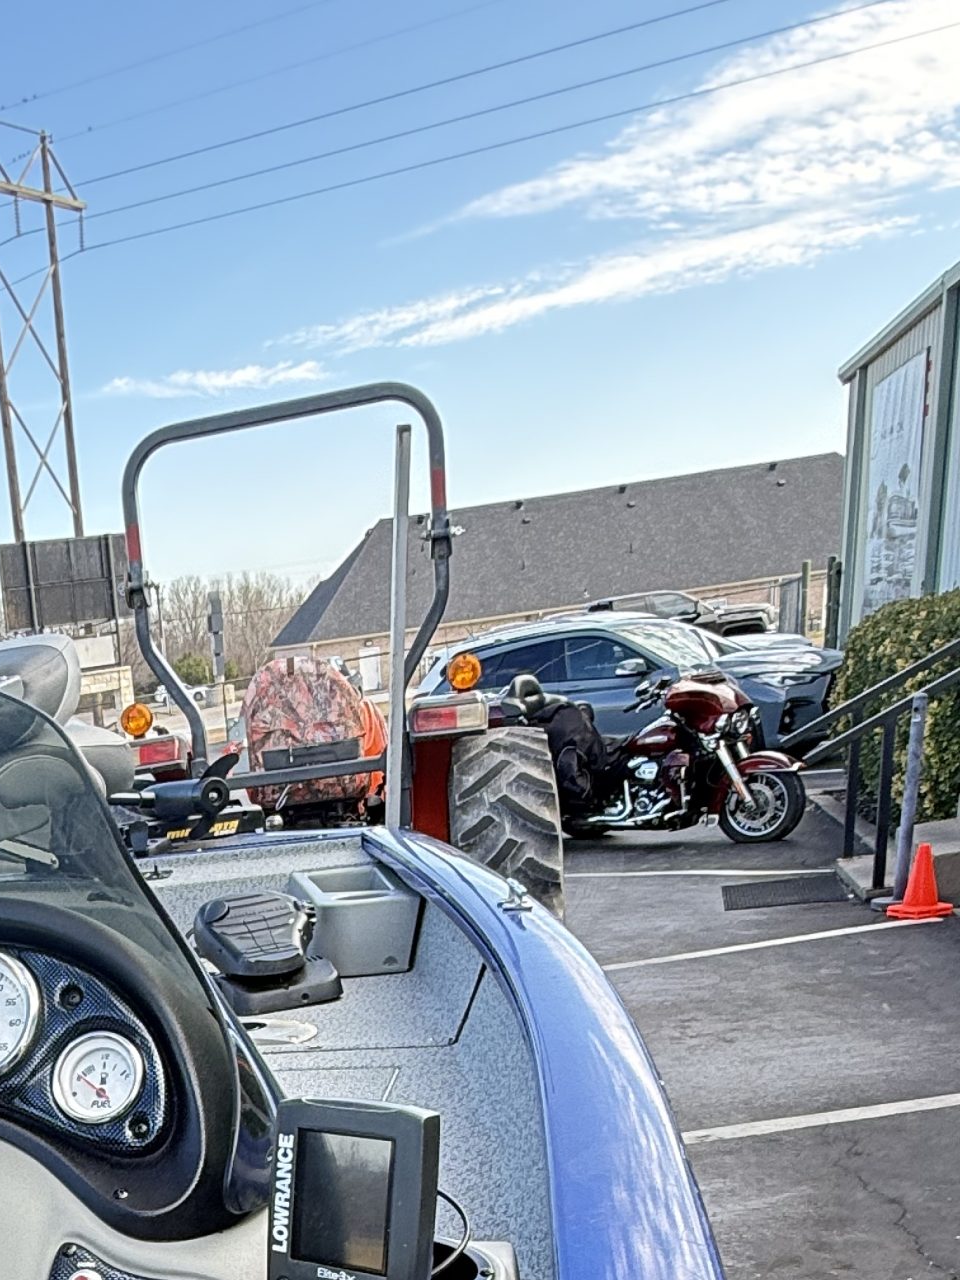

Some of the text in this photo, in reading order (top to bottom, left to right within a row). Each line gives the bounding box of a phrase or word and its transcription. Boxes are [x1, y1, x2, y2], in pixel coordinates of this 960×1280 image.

[8, 1019, 21, 1027] 60
[90, 1100, 112, 1108] FUEL
[272, 1133, 295, 1253] LOWRANCE
